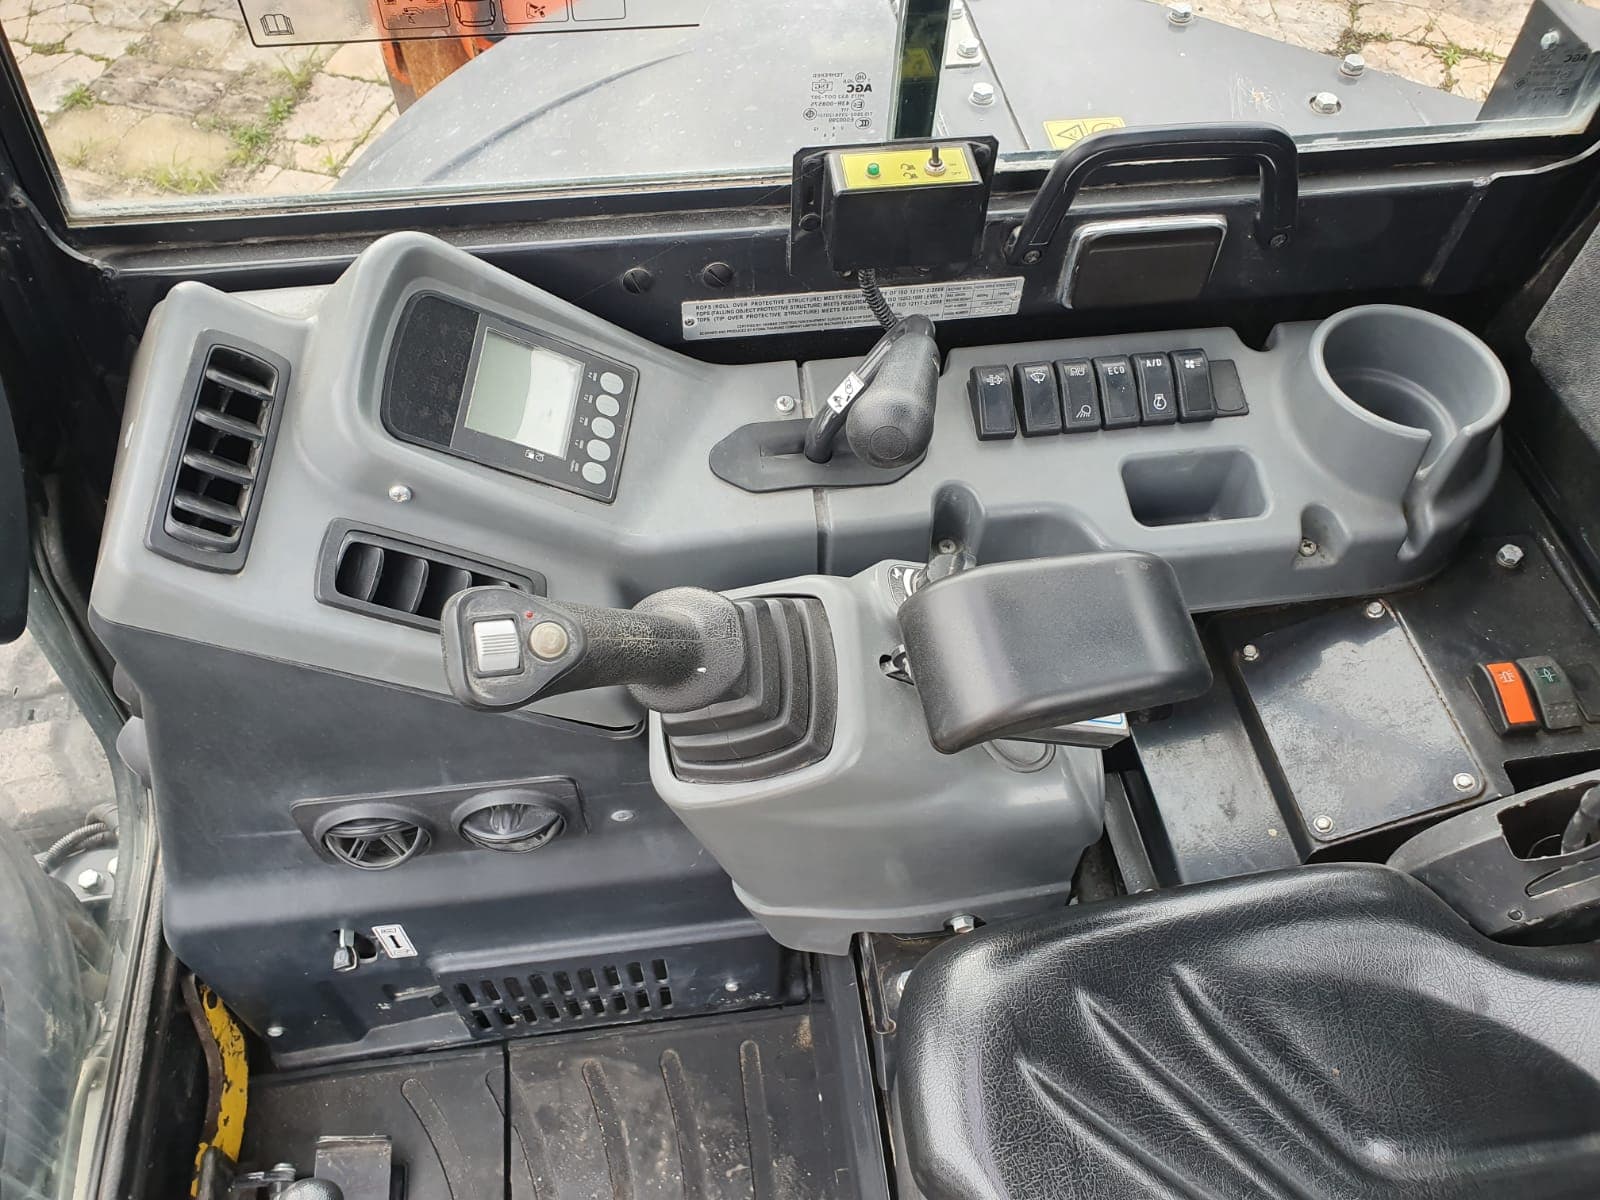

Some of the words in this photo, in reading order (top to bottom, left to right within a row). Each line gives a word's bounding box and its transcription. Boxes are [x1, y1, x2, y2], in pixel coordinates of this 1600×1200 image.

[789, 302, 822, 310] STRUCTURE)
[784, 309, 820, 317] STRUCTURE)
[1145, 358, 1162, 367] A/D
[1107, 366, 1125, 375] ECO
